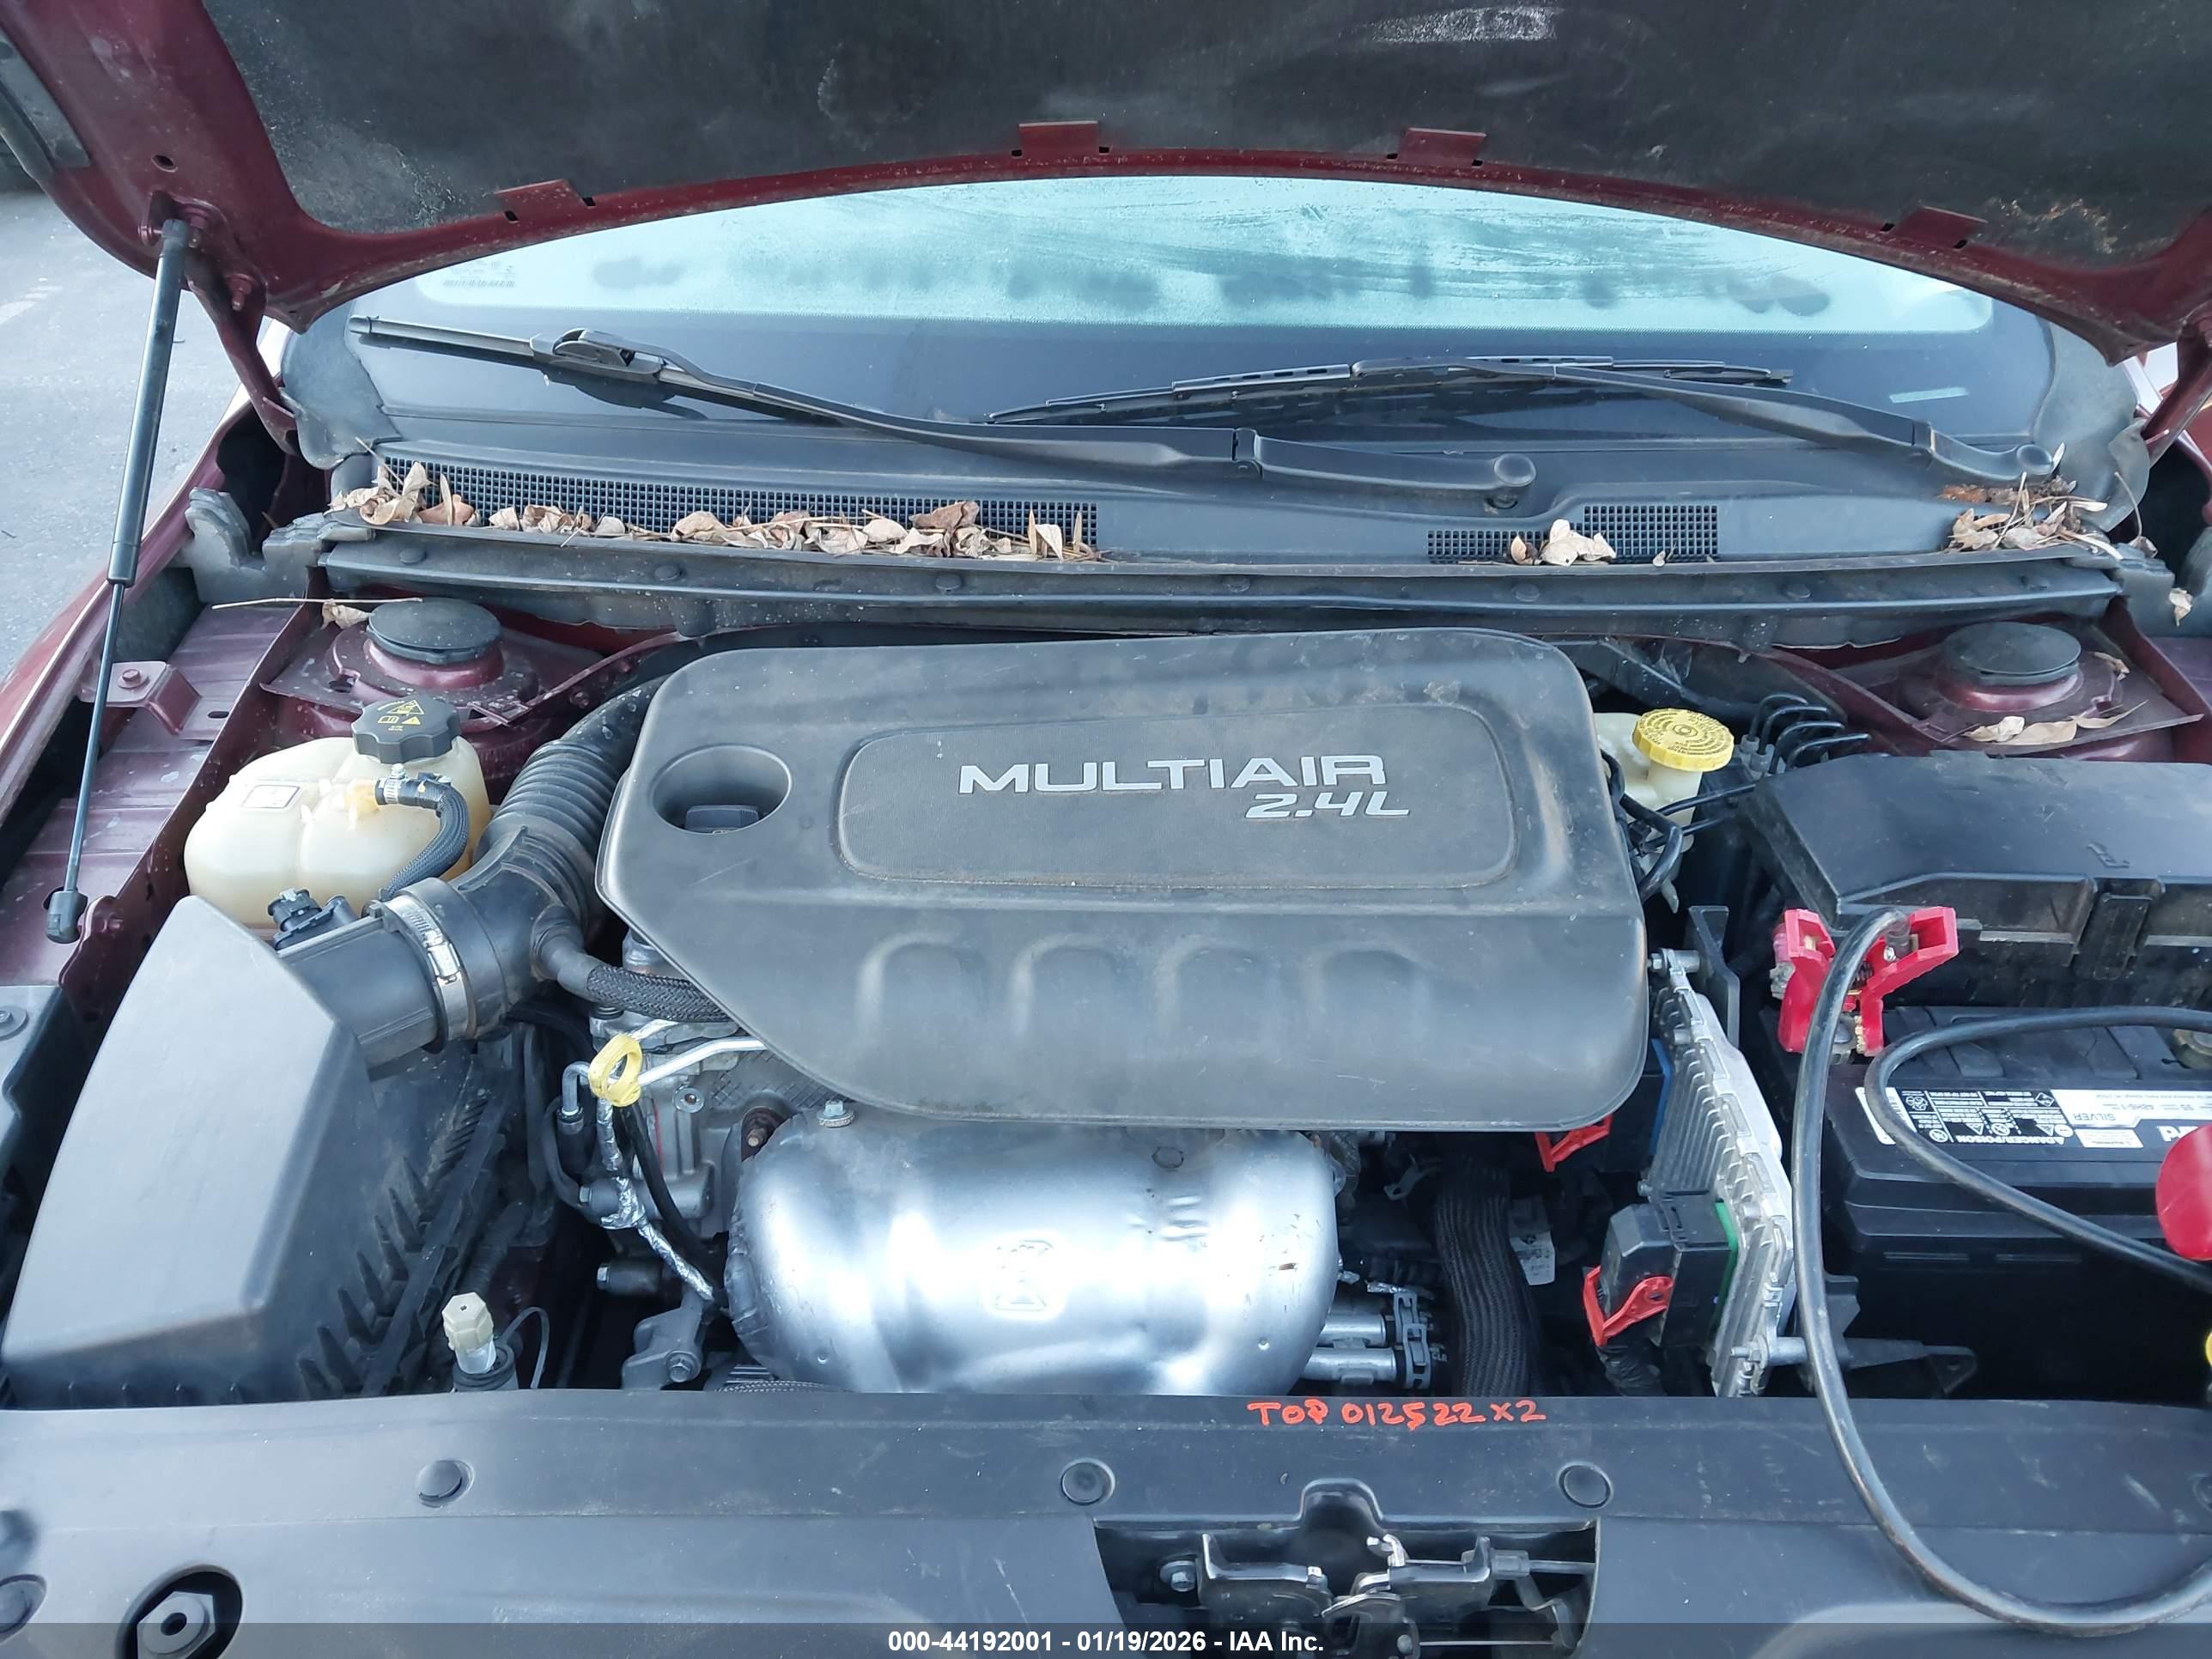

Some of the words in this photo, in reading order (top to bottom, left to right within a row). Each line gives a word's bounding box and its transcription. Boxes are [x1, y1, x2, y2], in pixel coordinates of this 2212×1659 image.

[959, 755, 1387, 793] MULTIAIR
[1245, 791, 1410, 818] 2.4L
[2073, 1113, 2117, 1121] SILVER
